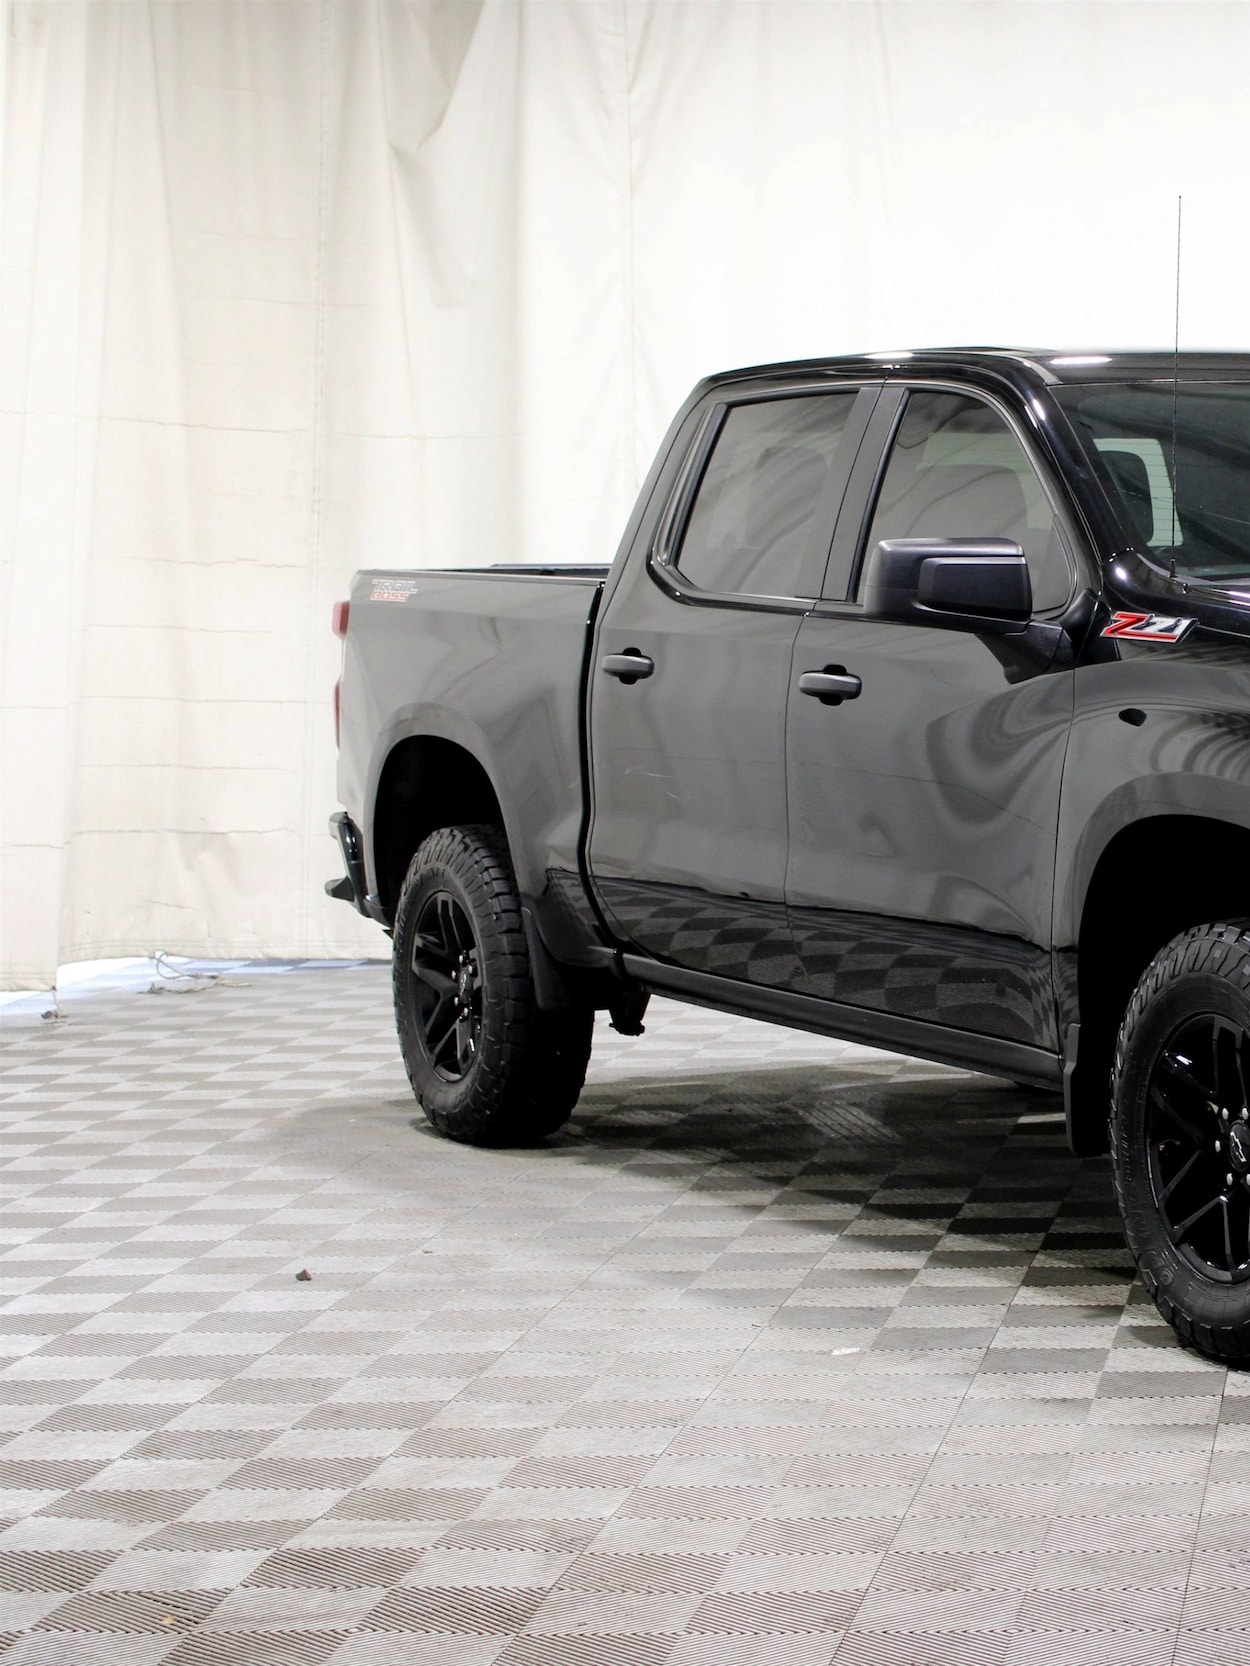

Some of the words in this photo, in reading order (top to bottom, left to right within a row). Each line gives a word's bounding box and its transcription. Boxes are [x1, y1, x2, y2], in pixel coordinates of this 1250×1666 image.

[371, 579, 418, 592] TRAIL
[369, 591, 410, 602] BOSS
[1099, 611, 1197, 644] Z71
